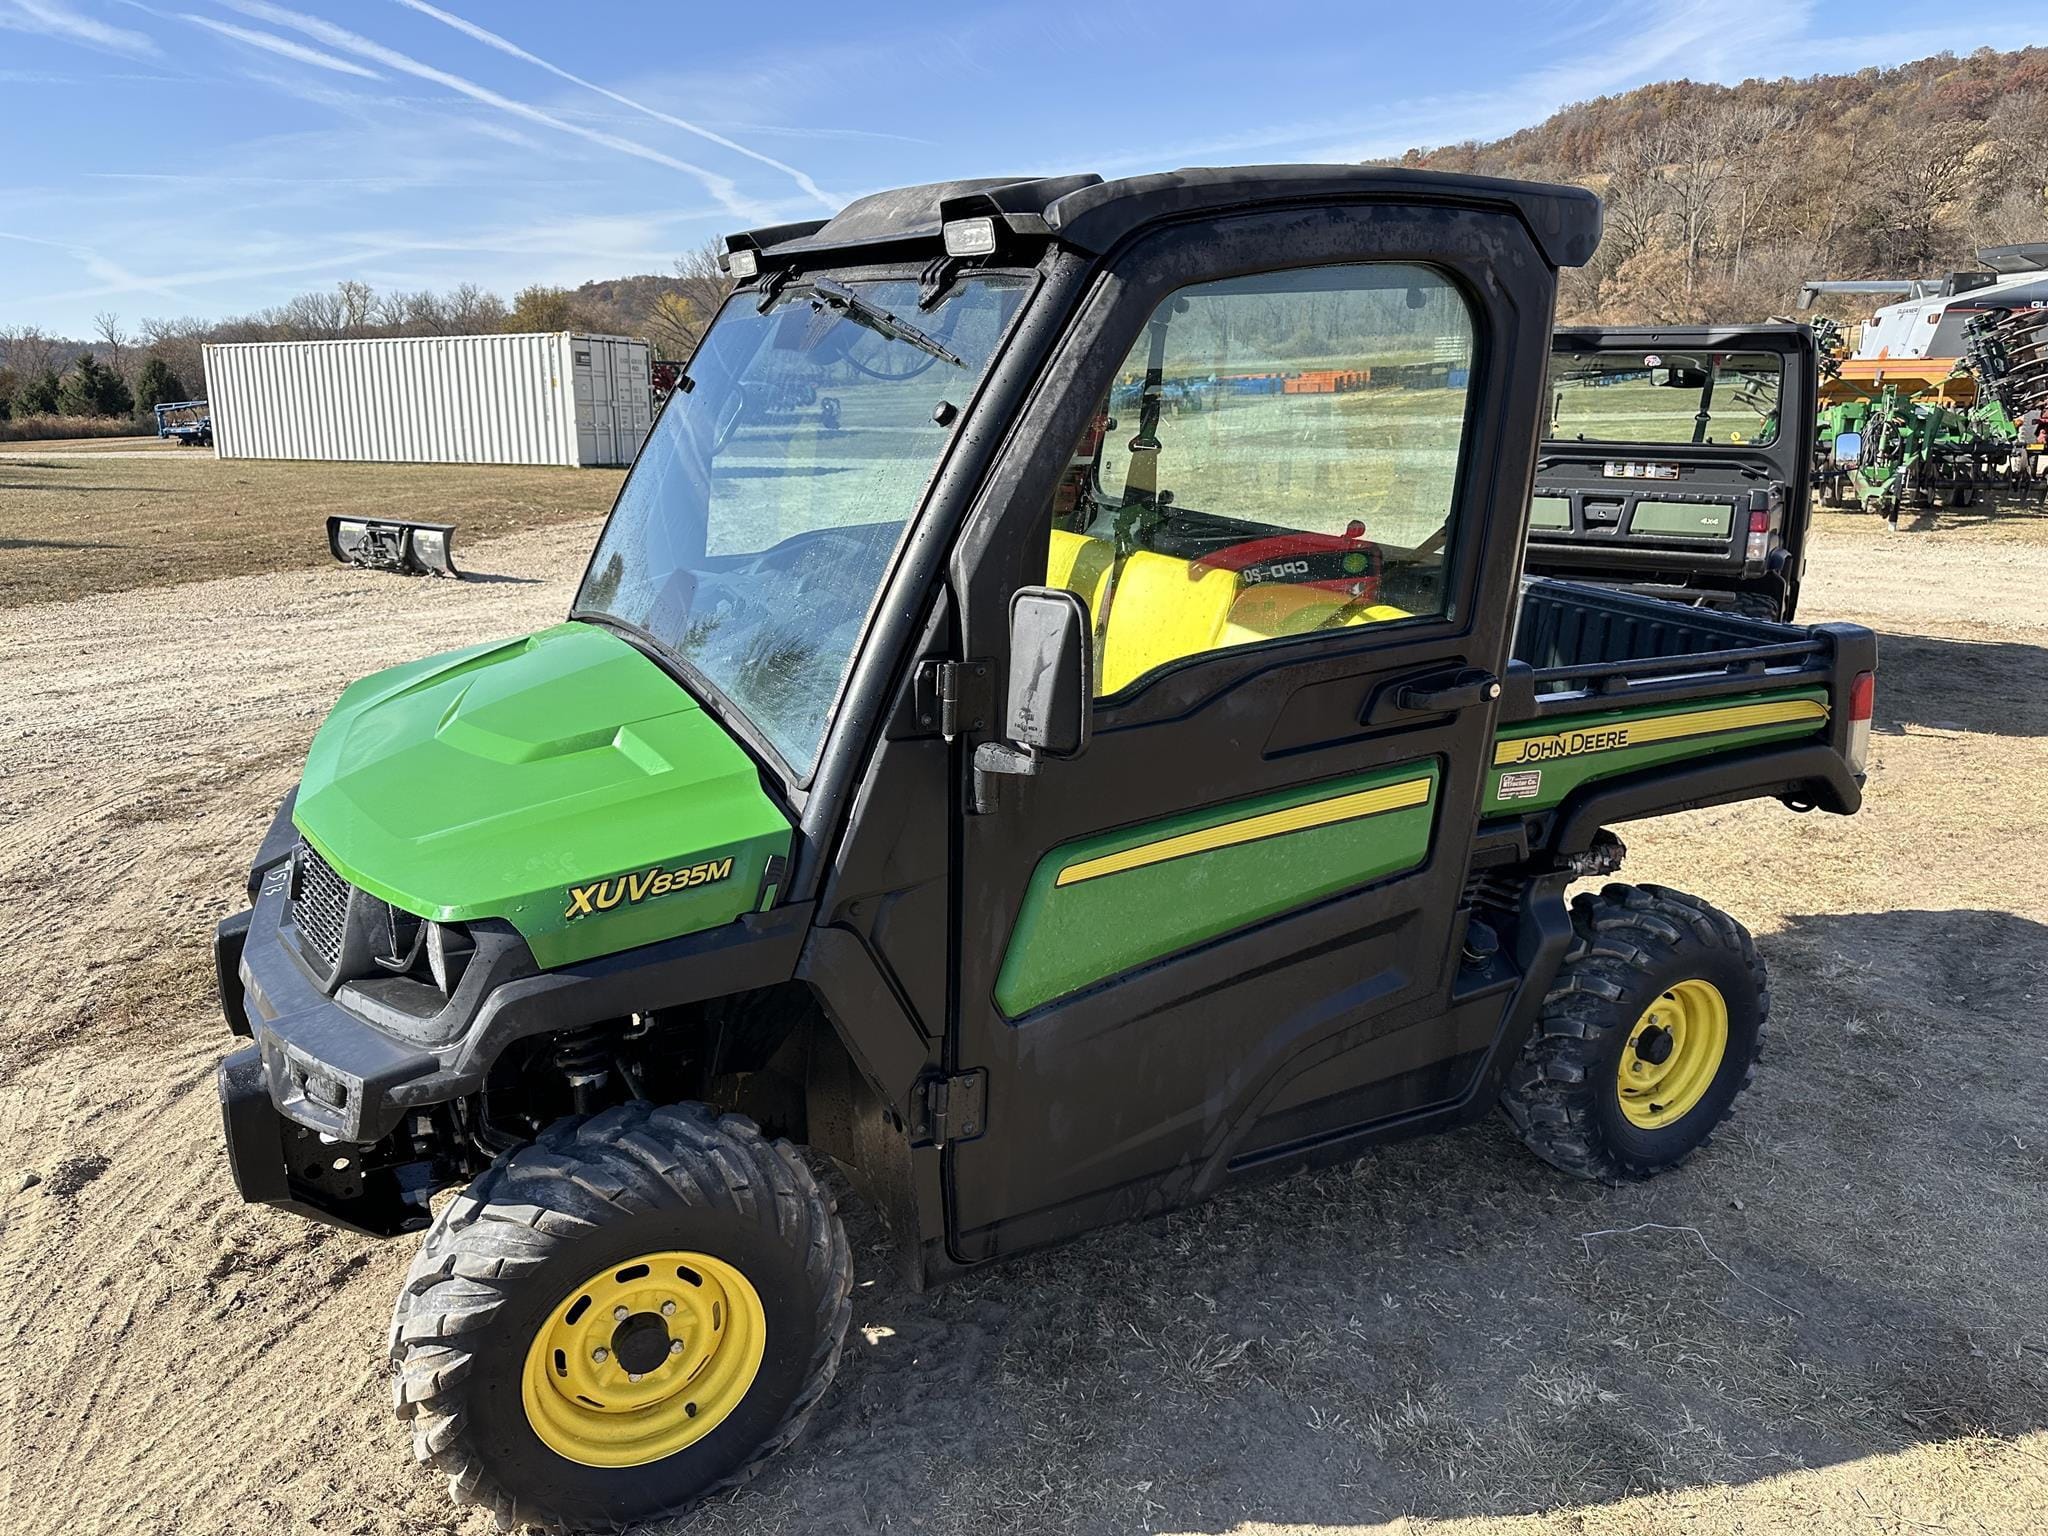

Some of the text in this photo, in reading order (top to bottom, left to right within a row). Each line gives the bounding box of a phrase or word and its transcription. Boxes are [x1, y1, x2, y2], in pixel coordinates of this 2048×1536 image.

[2031, 301, 2048, 309] GL
[1700, 517, 1719, 525] 4x4
[1516, 730, 1629, 761] JOHN DEERE
